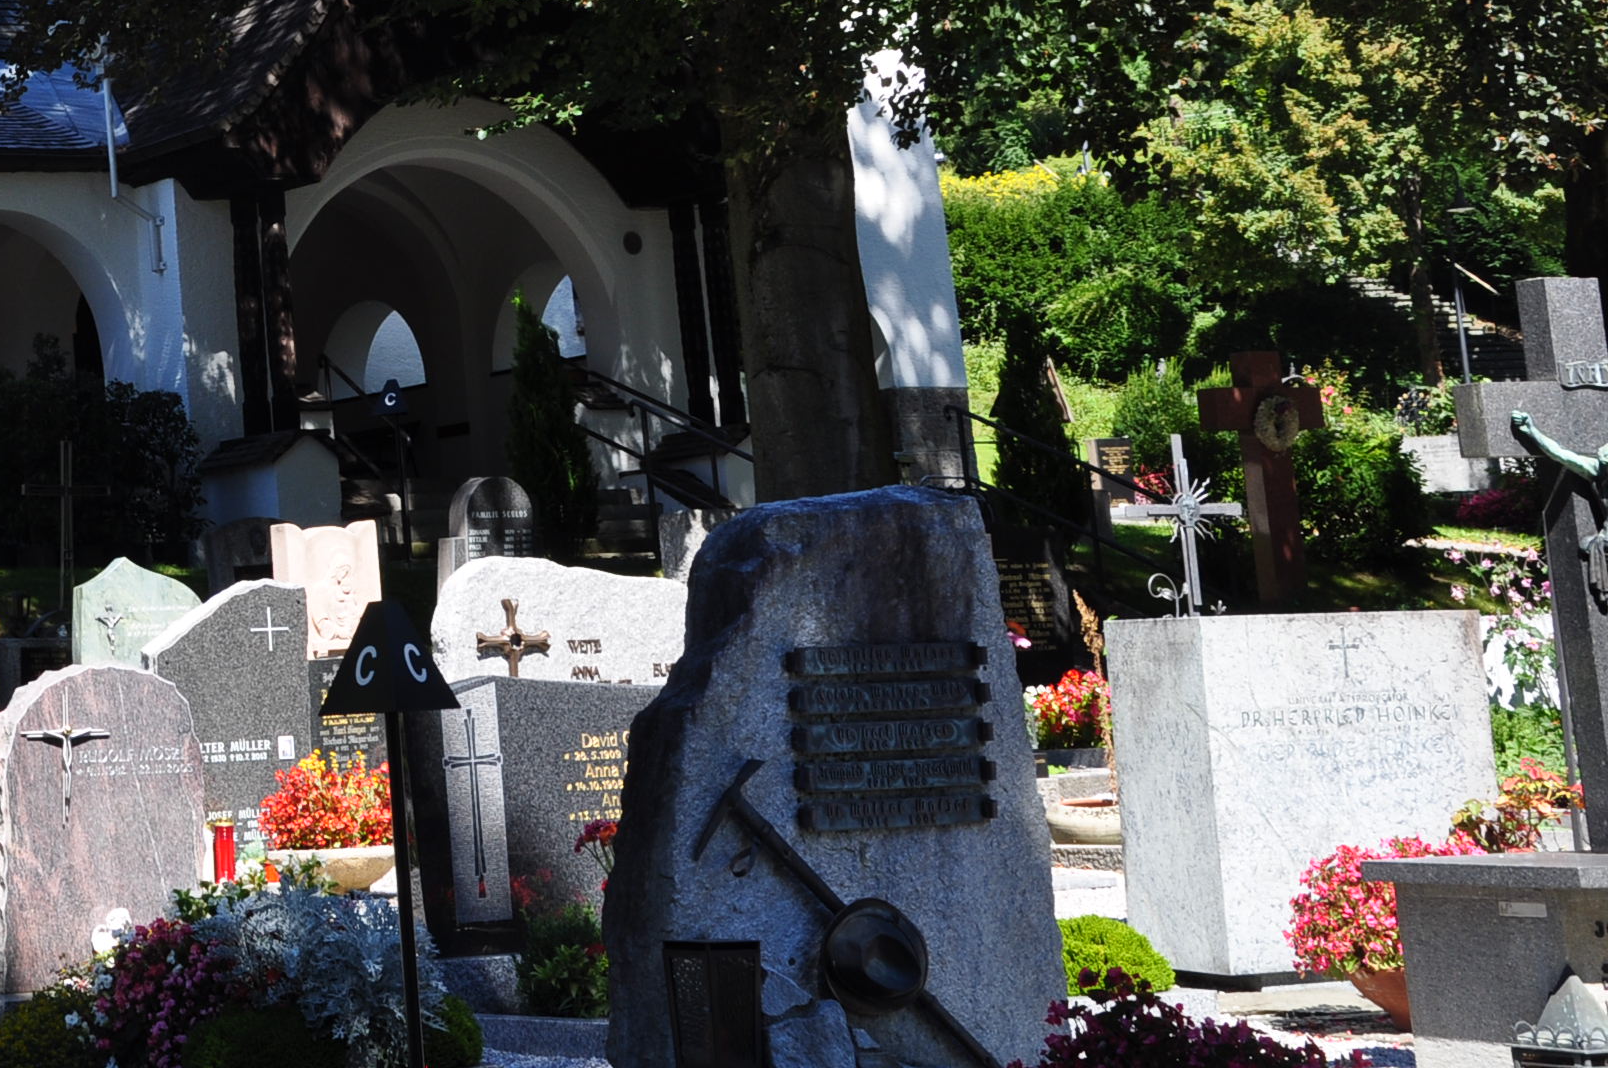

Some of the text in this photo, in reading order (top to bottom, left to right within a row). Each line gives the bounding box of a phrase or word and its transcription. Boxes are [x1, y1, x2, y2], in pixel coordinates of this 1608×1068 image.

[384, 393, 396, 406] C
[355, 645, 377, 686] C
[404, 643, 427, 683] C
[570, 665, 601, 681] ANNA
[230, 738, 272, 752] MÜLLER
[581, 732, 618, 748] David
[79, 749, 134, 764] RUDOLF
[585, 763, 620, 779] Anna
